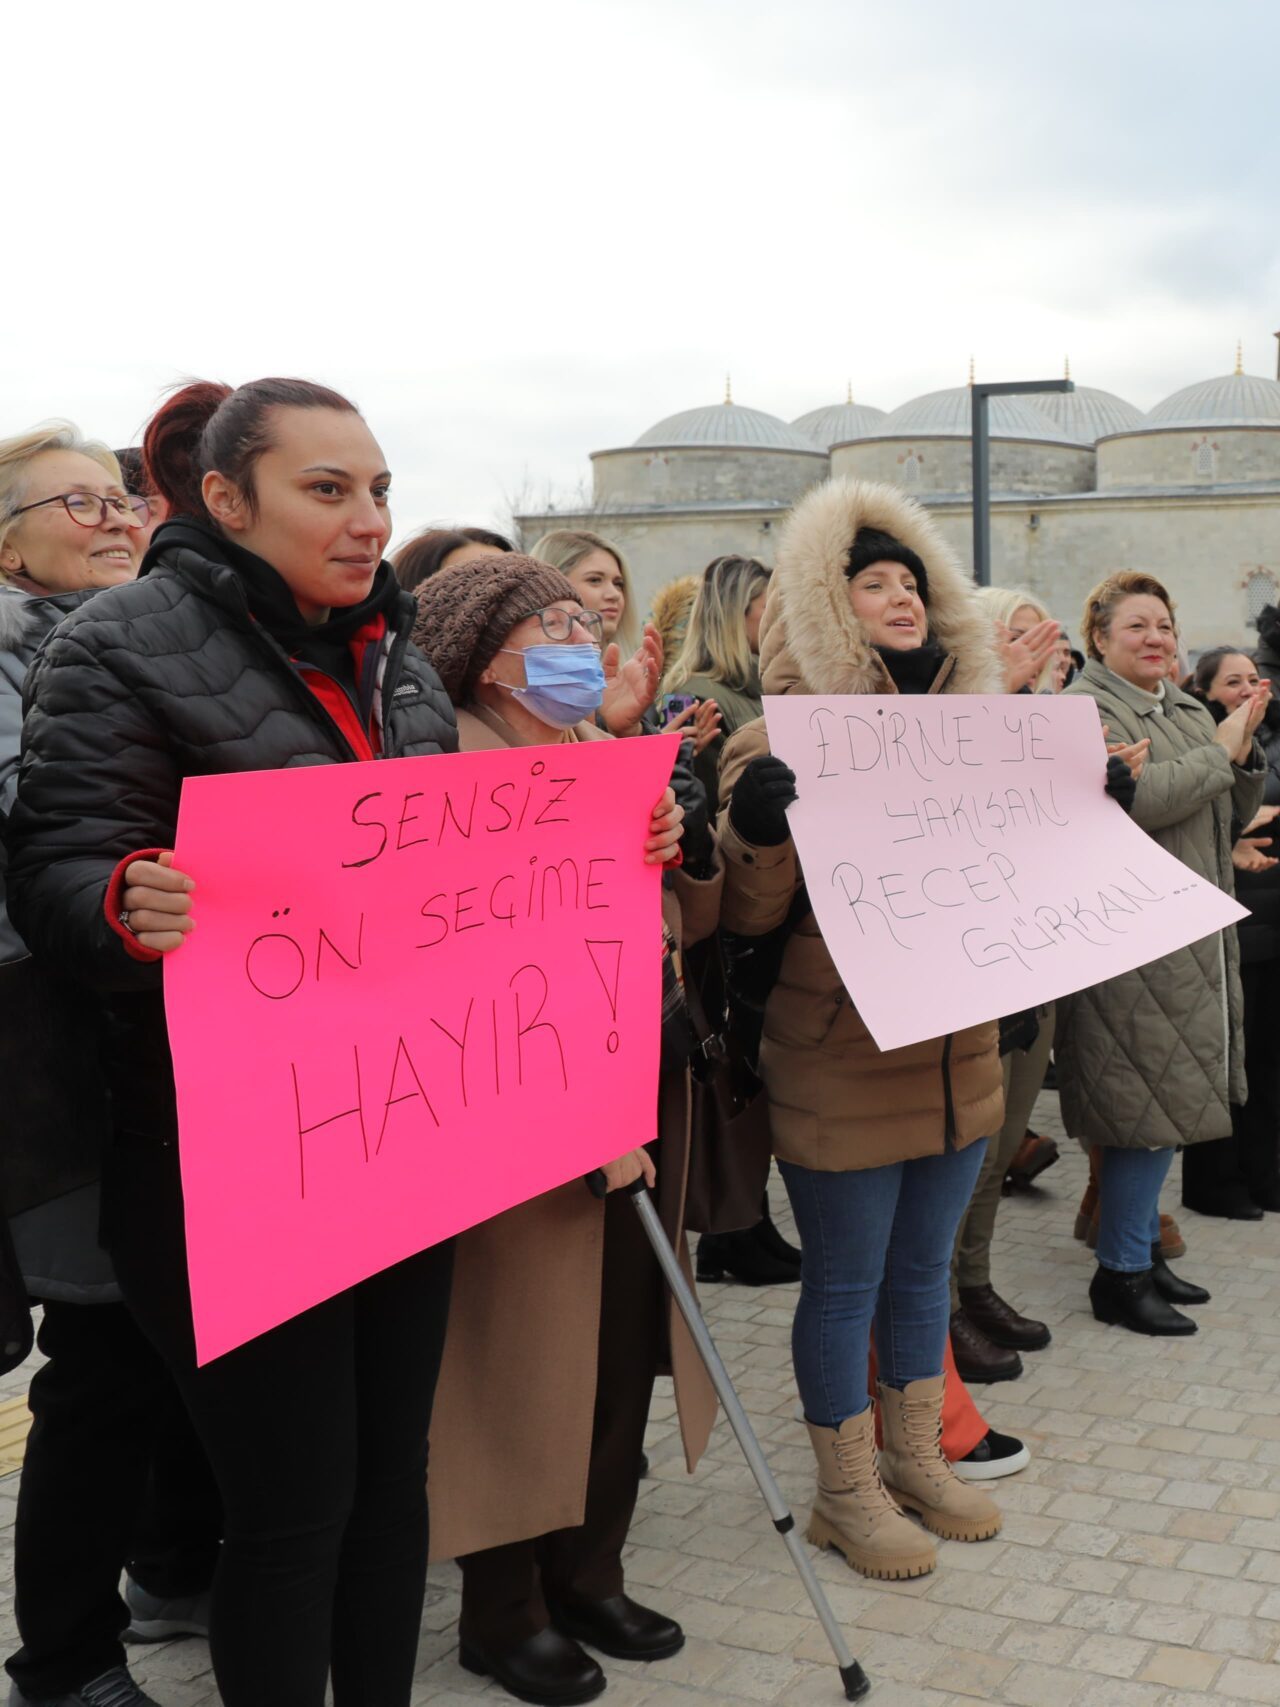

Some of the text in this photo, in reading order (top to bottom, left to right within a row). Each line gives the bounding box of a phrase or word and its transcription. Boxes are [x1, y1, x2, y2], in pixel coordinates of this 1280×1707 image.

[341, 761, 577, 868] SENSİZ
[831, 853, 1020, 950] RECEP
[246, 907, 364, 999] ÖN
[291, 964, 568, 1200] HAYIR
